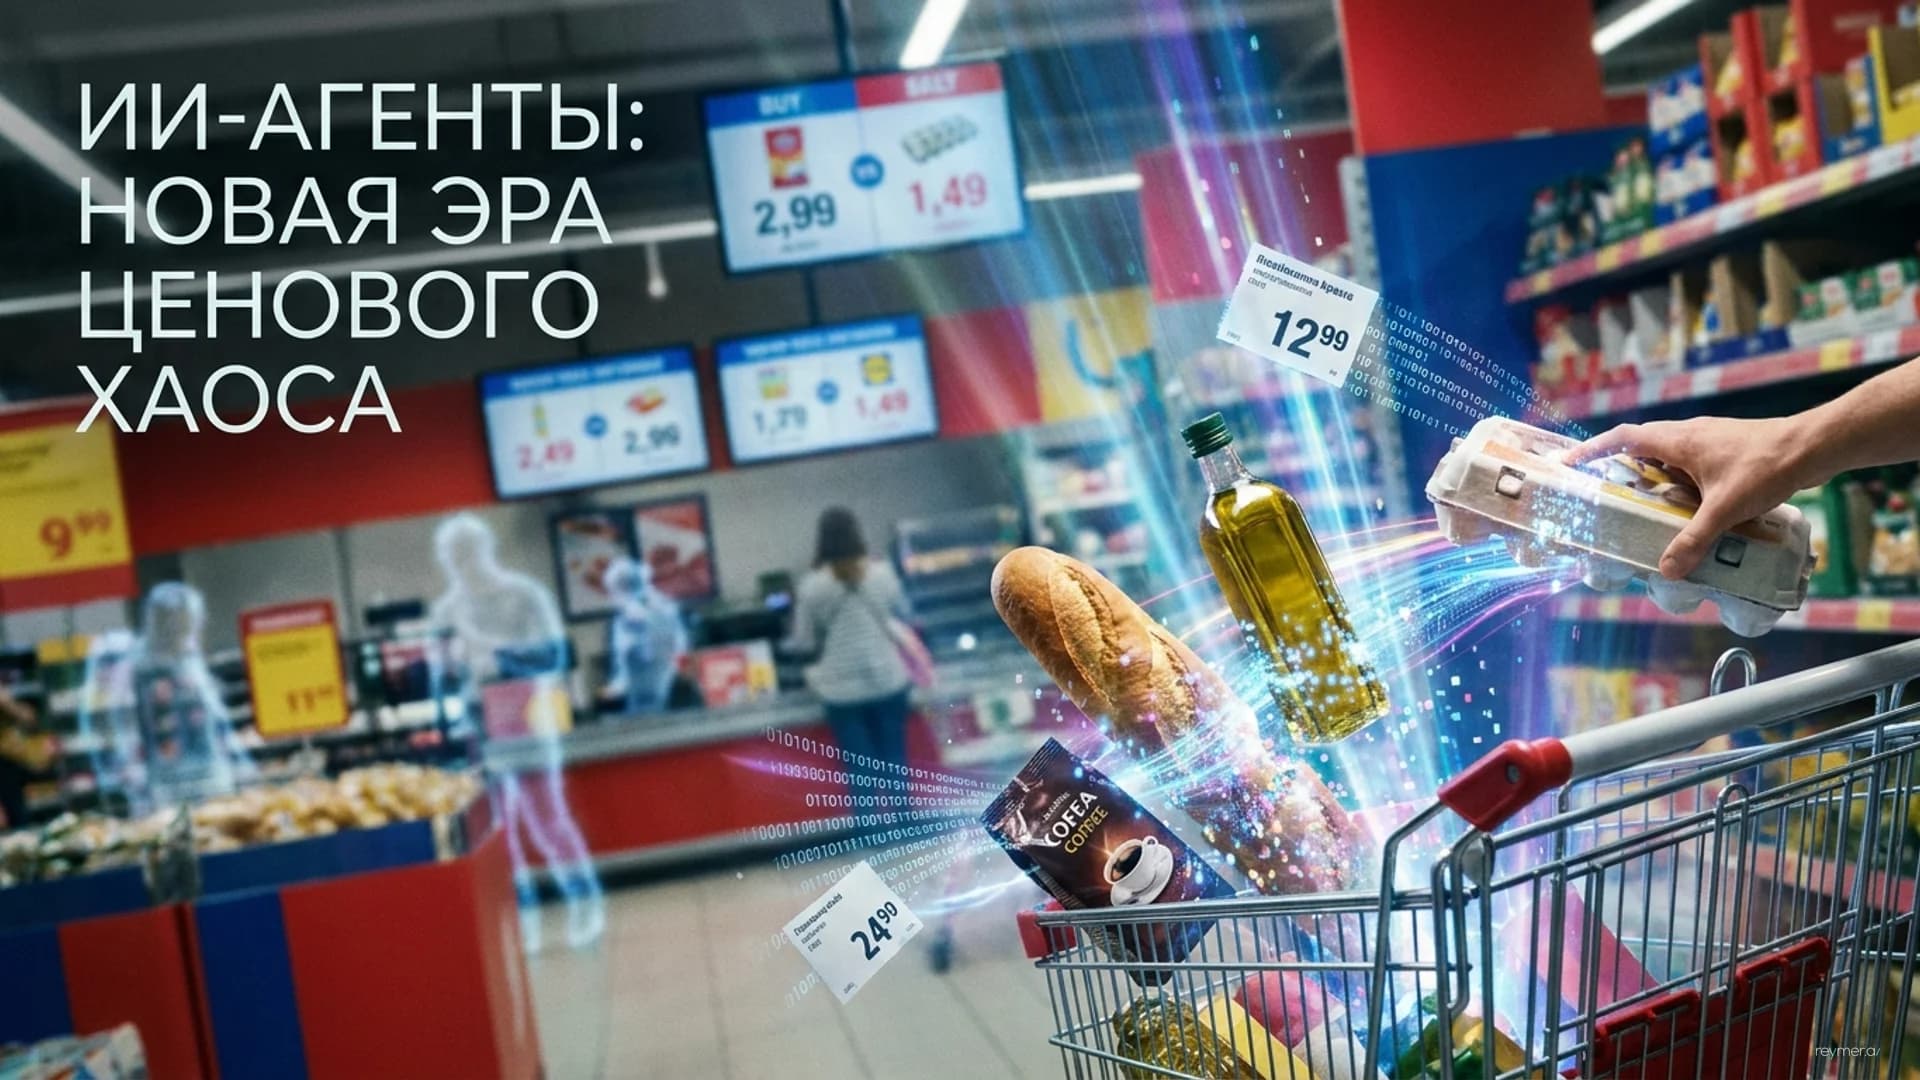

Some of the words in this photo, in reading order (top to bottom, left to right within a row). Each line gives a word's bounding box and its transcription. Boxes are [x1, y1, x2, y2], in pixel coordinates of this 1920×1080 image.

[758, 93, 801, 118] BUY
[754, 192, 837, 239] 2,99
[908, 171, 988, 217] 1,49
